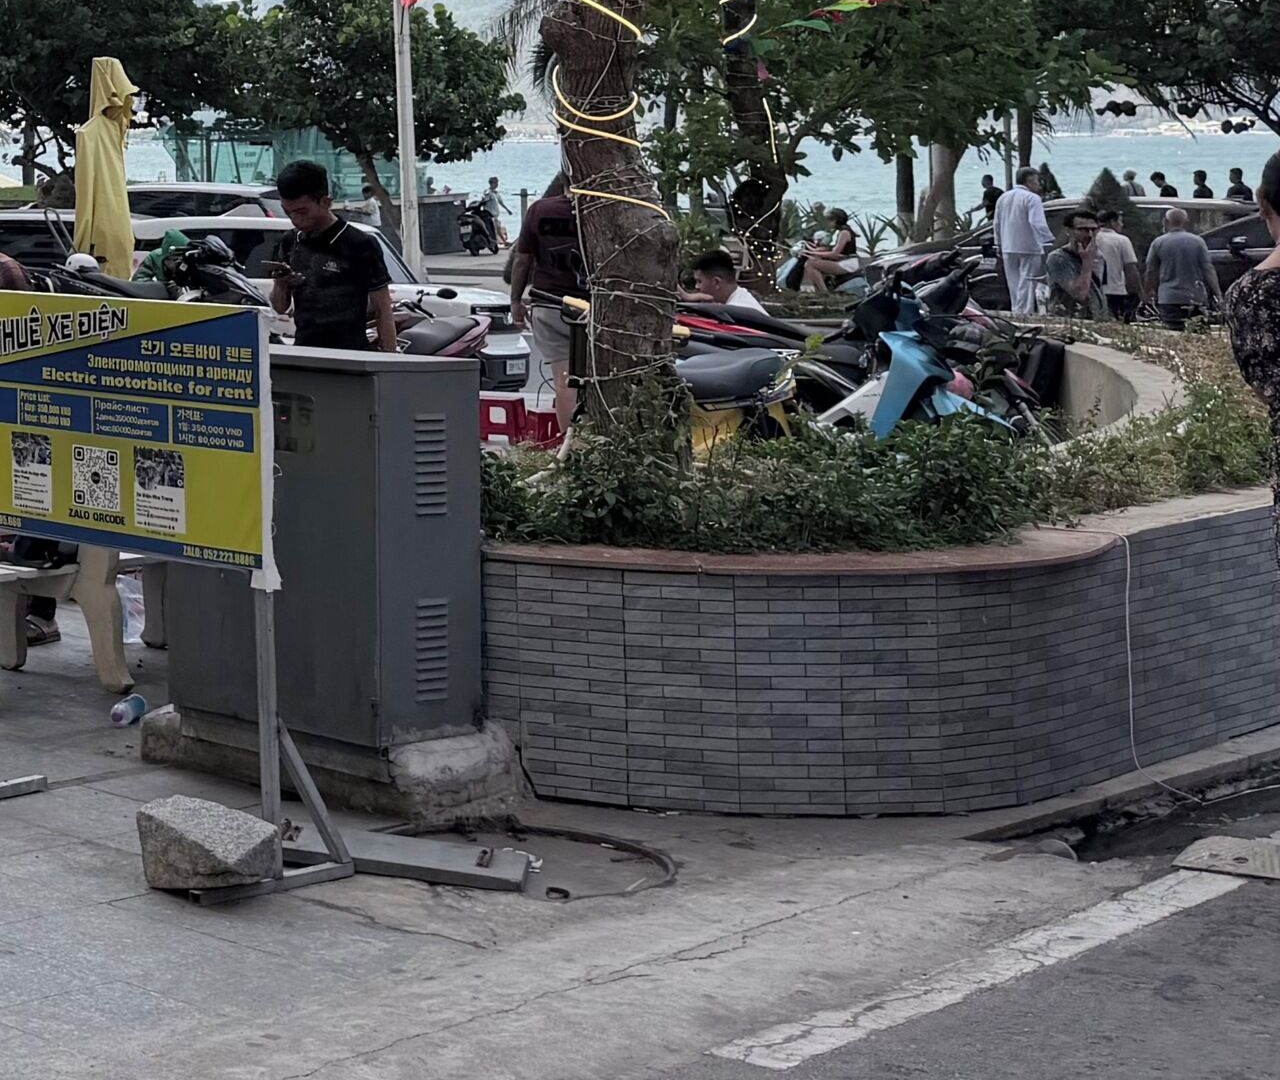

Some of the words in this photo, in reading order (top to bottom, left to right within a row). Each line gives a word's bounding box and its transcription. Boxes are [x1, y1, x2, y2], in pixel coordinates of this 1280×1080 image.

[47, 312, 75, 346] XE
[77, 302, 127, 340] ĐIỆN
[140, 340, 165, 356] 전기
[170, 343, 220, 360] 오토바이
[225, 347, 253, 363] 렌트
[87, 354, 194, 377] Электромотоцикл
[196, 366, 204, 377] в
[206, 366, 253, 384] аренду
[42, 367, 97, 385] Electric
[101, 375, 182, 394] motorbike
[187, 382, 213, 396] for
[217, 386, 254, 400] rent
[176, 409, 204, 421] 가격표:
[225, 426, 242, 437] VND
[227, 438, 244, 448] VND
[68, 508, 89, 520] ZALO
[93, 511, 126, 526] QRCODE
[183, 545, 202, 556] ZALO:
